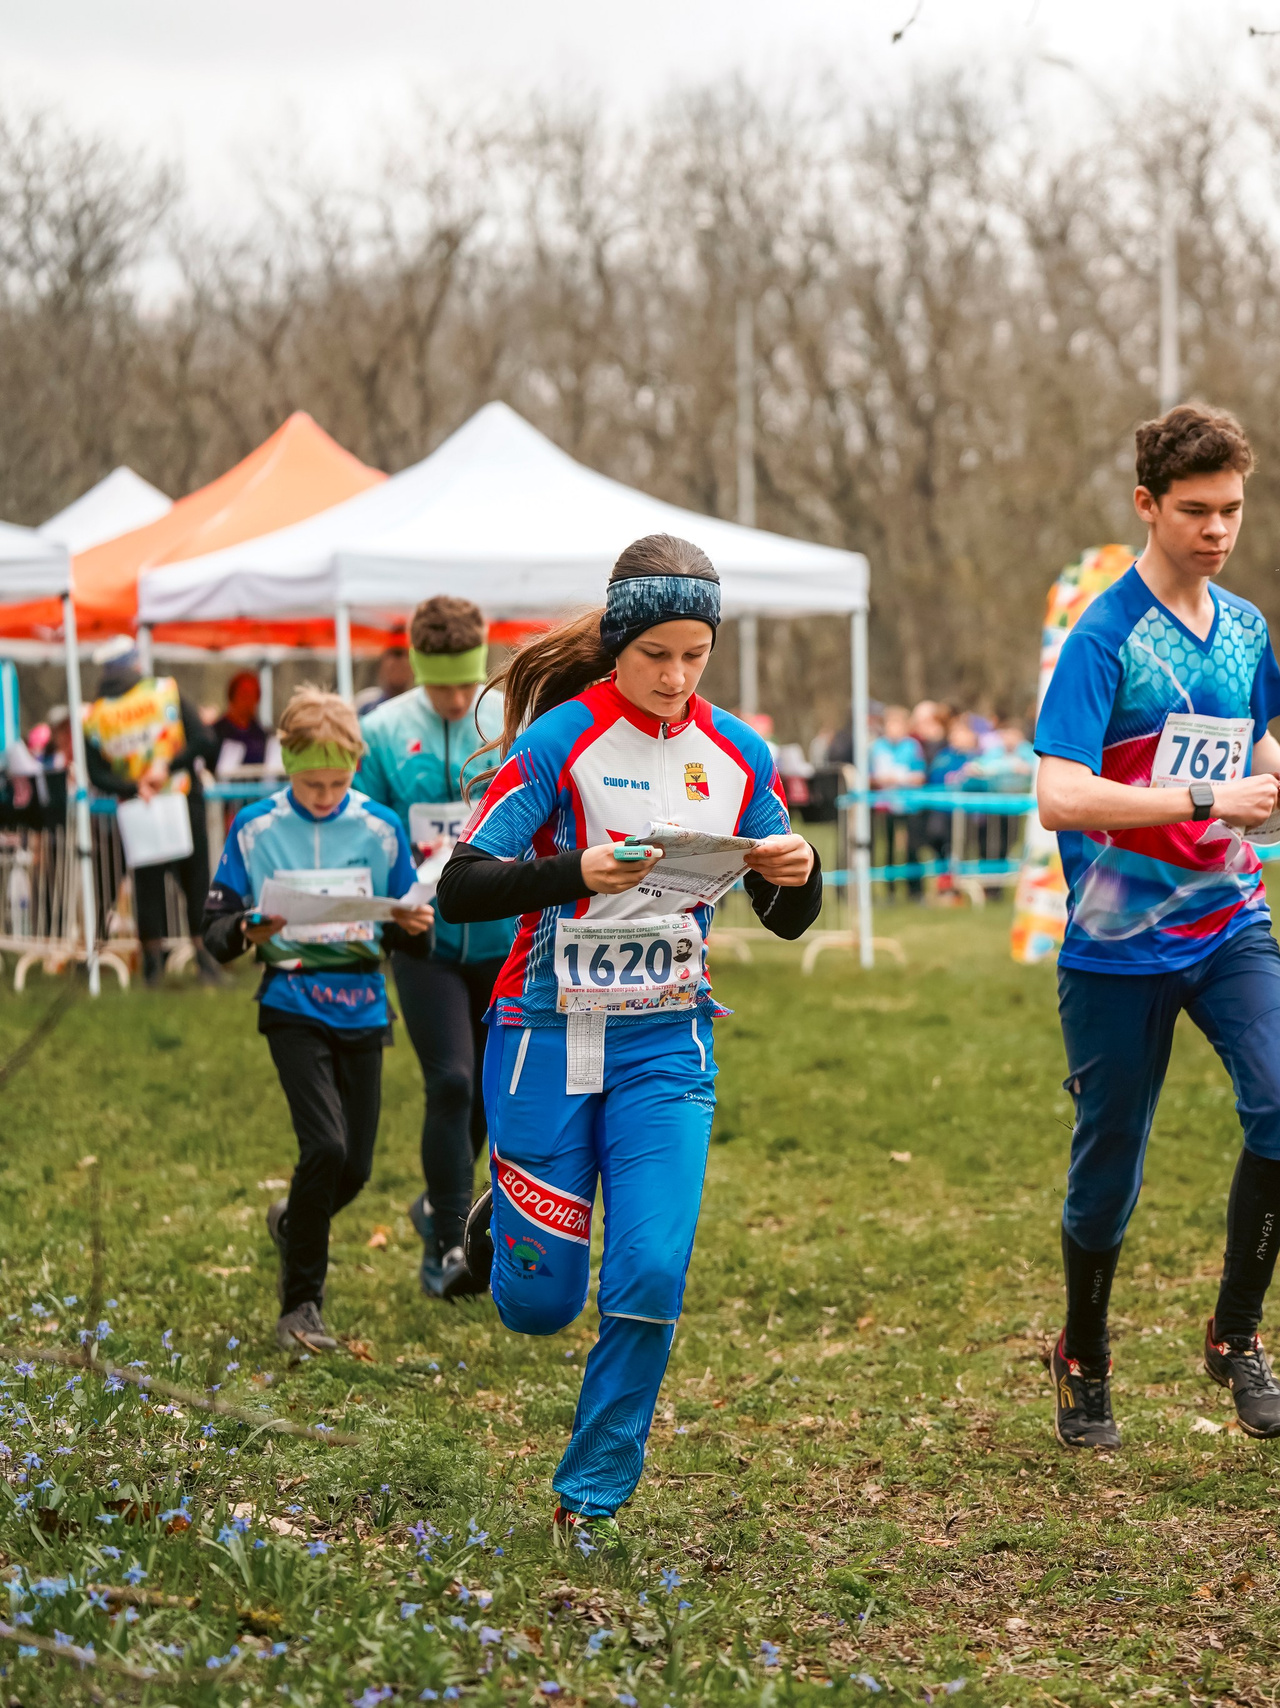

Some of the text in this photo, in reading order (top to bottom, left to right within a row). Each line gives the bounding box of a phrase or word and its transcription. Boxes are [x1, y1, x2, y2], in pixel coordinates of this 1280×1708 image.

[1169, 735, 1230, 781] 762
[603, 776, 650, 791] СШОР №18
[563, 939, 673, 987] 1620
[502, 1169, 589, 1232] ВОРОНЕЖ
